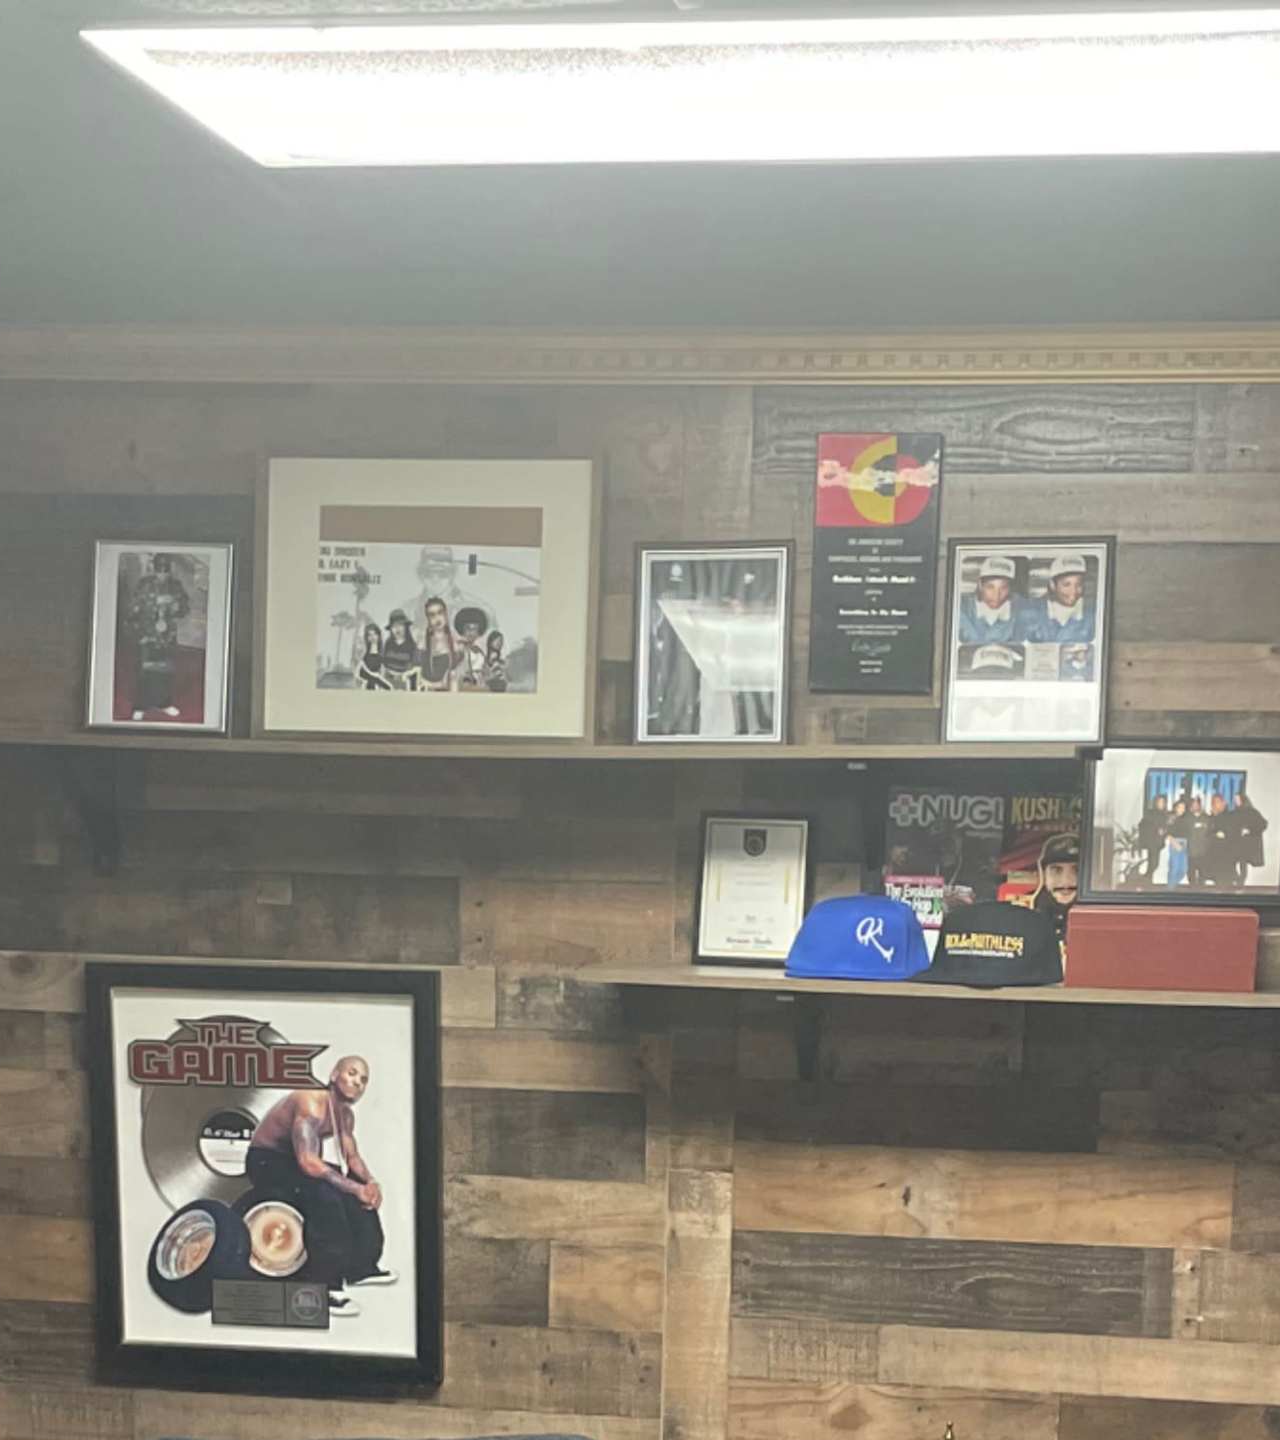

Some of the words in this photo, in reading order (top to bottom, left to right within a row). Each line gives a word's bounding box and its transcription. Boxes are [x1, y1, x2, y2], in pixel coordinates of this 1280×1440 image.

[1011, 796, 1060, 824] KUSH
[188, 1018, 265, 1047] THE
[130, 1041, 326, 1087] GAME
